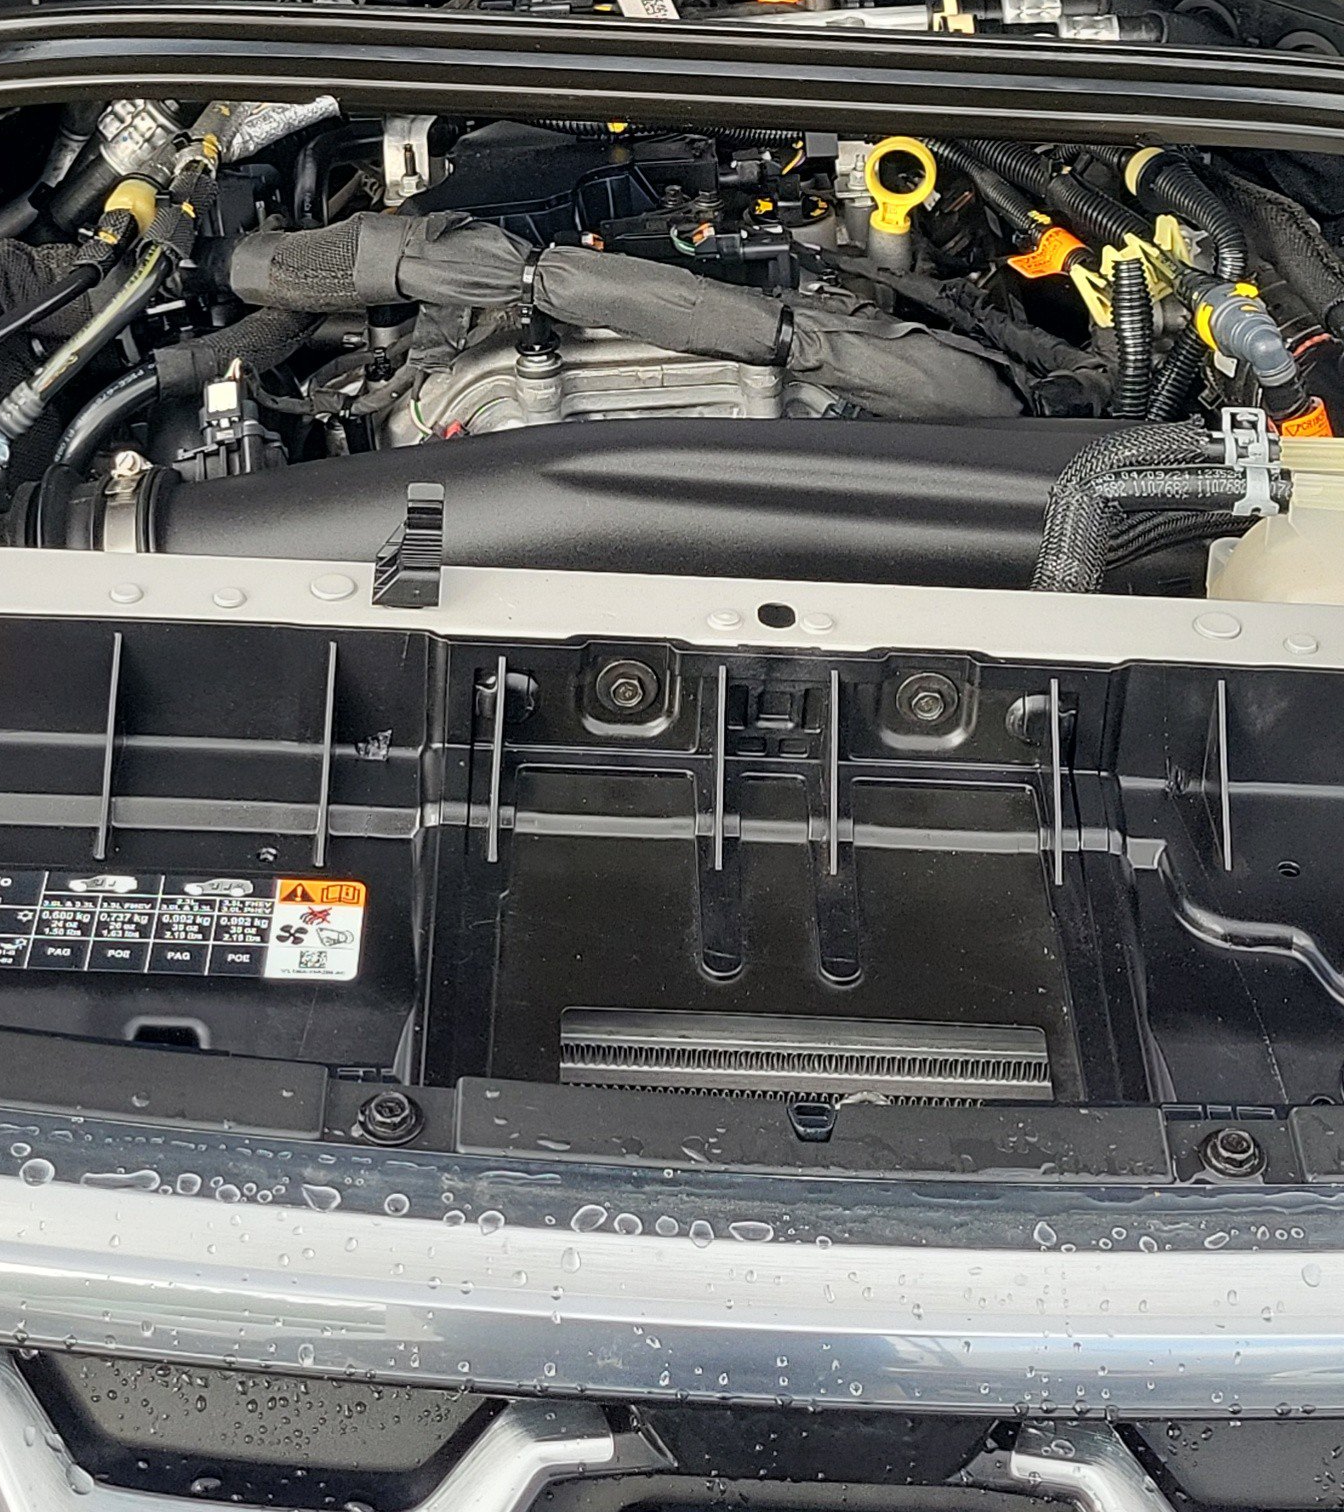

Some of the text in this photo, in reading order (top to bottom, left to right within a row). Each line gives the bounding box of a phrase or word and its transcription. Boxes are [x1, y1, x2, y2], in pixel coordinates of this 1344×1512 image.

[75, 911, 91, 922] kg
[99, 912, 149, 925] 0.737 kg
[196, 915, 211, 926] kg
[65, 921, 79, 929] oz
[123, 923, 136, 931] oz
[254, 917, 269, 929] kg
[66, 928, 82, 936] lbs
[186, 924, 199, 932] oz
[187, 932, 203, 940] lbs
[245, 934, 262, 942] lbs
[47, 947, 71, 956] PAG
[107, 949, 131, 959] POE
[167, 951, 191, 961] PAG
[227, 953, 251, 963] POE
